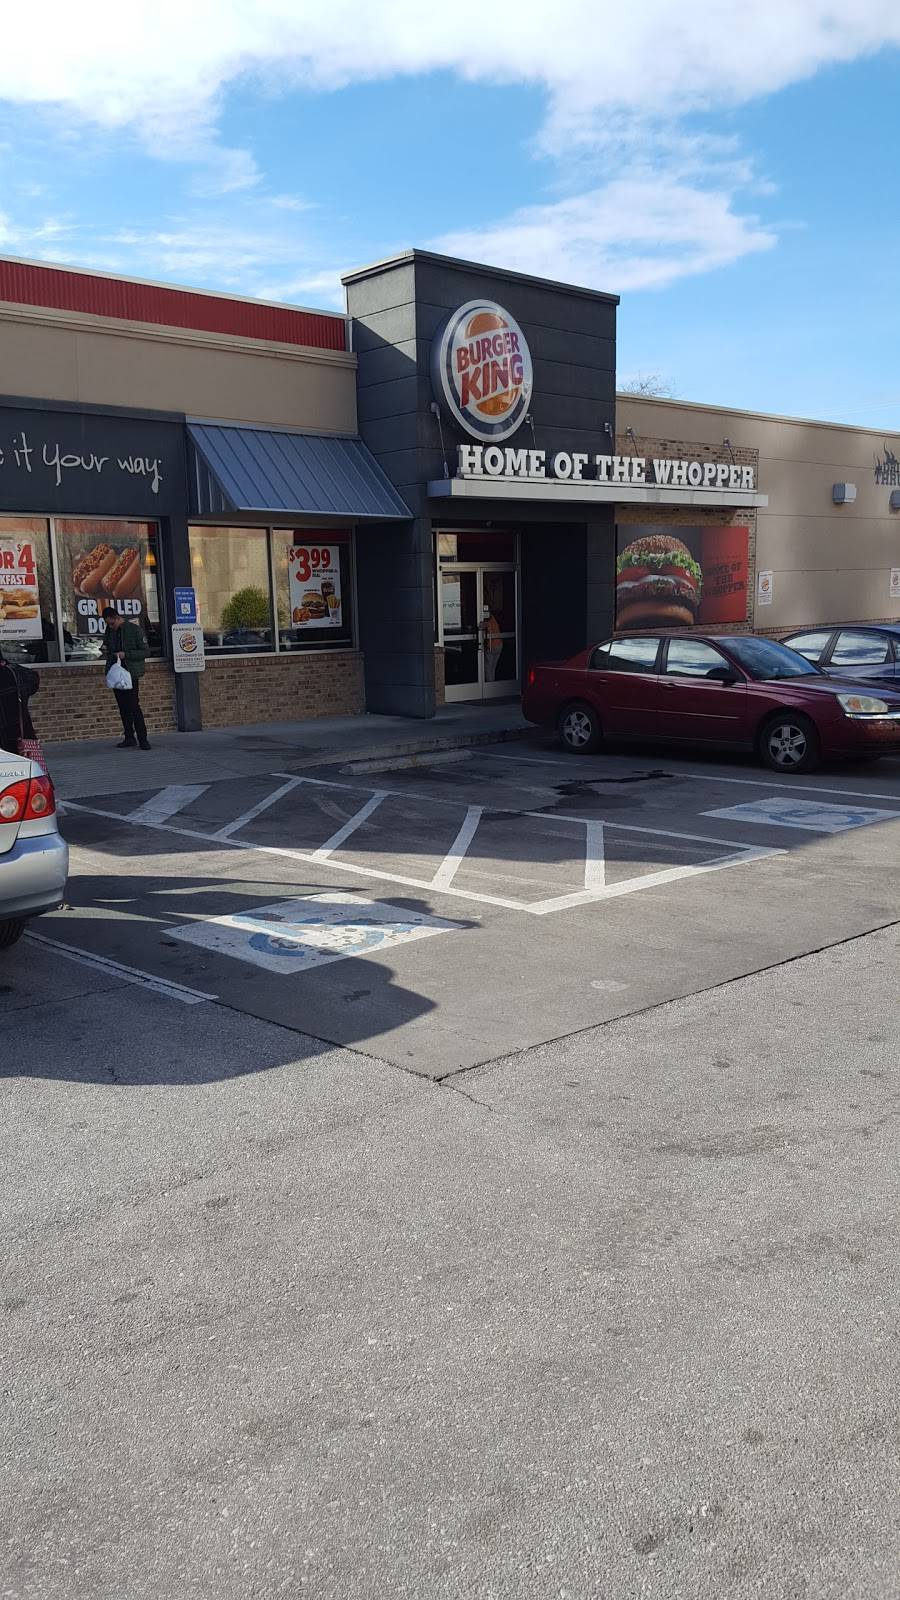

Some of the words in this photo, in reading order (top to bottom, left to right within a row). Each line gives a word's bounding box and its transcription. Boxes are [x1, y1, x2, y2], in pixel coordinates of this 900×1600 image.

[456, 332, 520, 373] BURGER
[460, 354, 524, 408] KING
[13, 432, 33, 472] it
[459, 444, 546, 478] HOME
[553, 452, 589, 480] OF
[596, 454, 646, 483] THE
[652, 459, 755, 489] WHOPPER
[17, 543, 37, 574] $4
